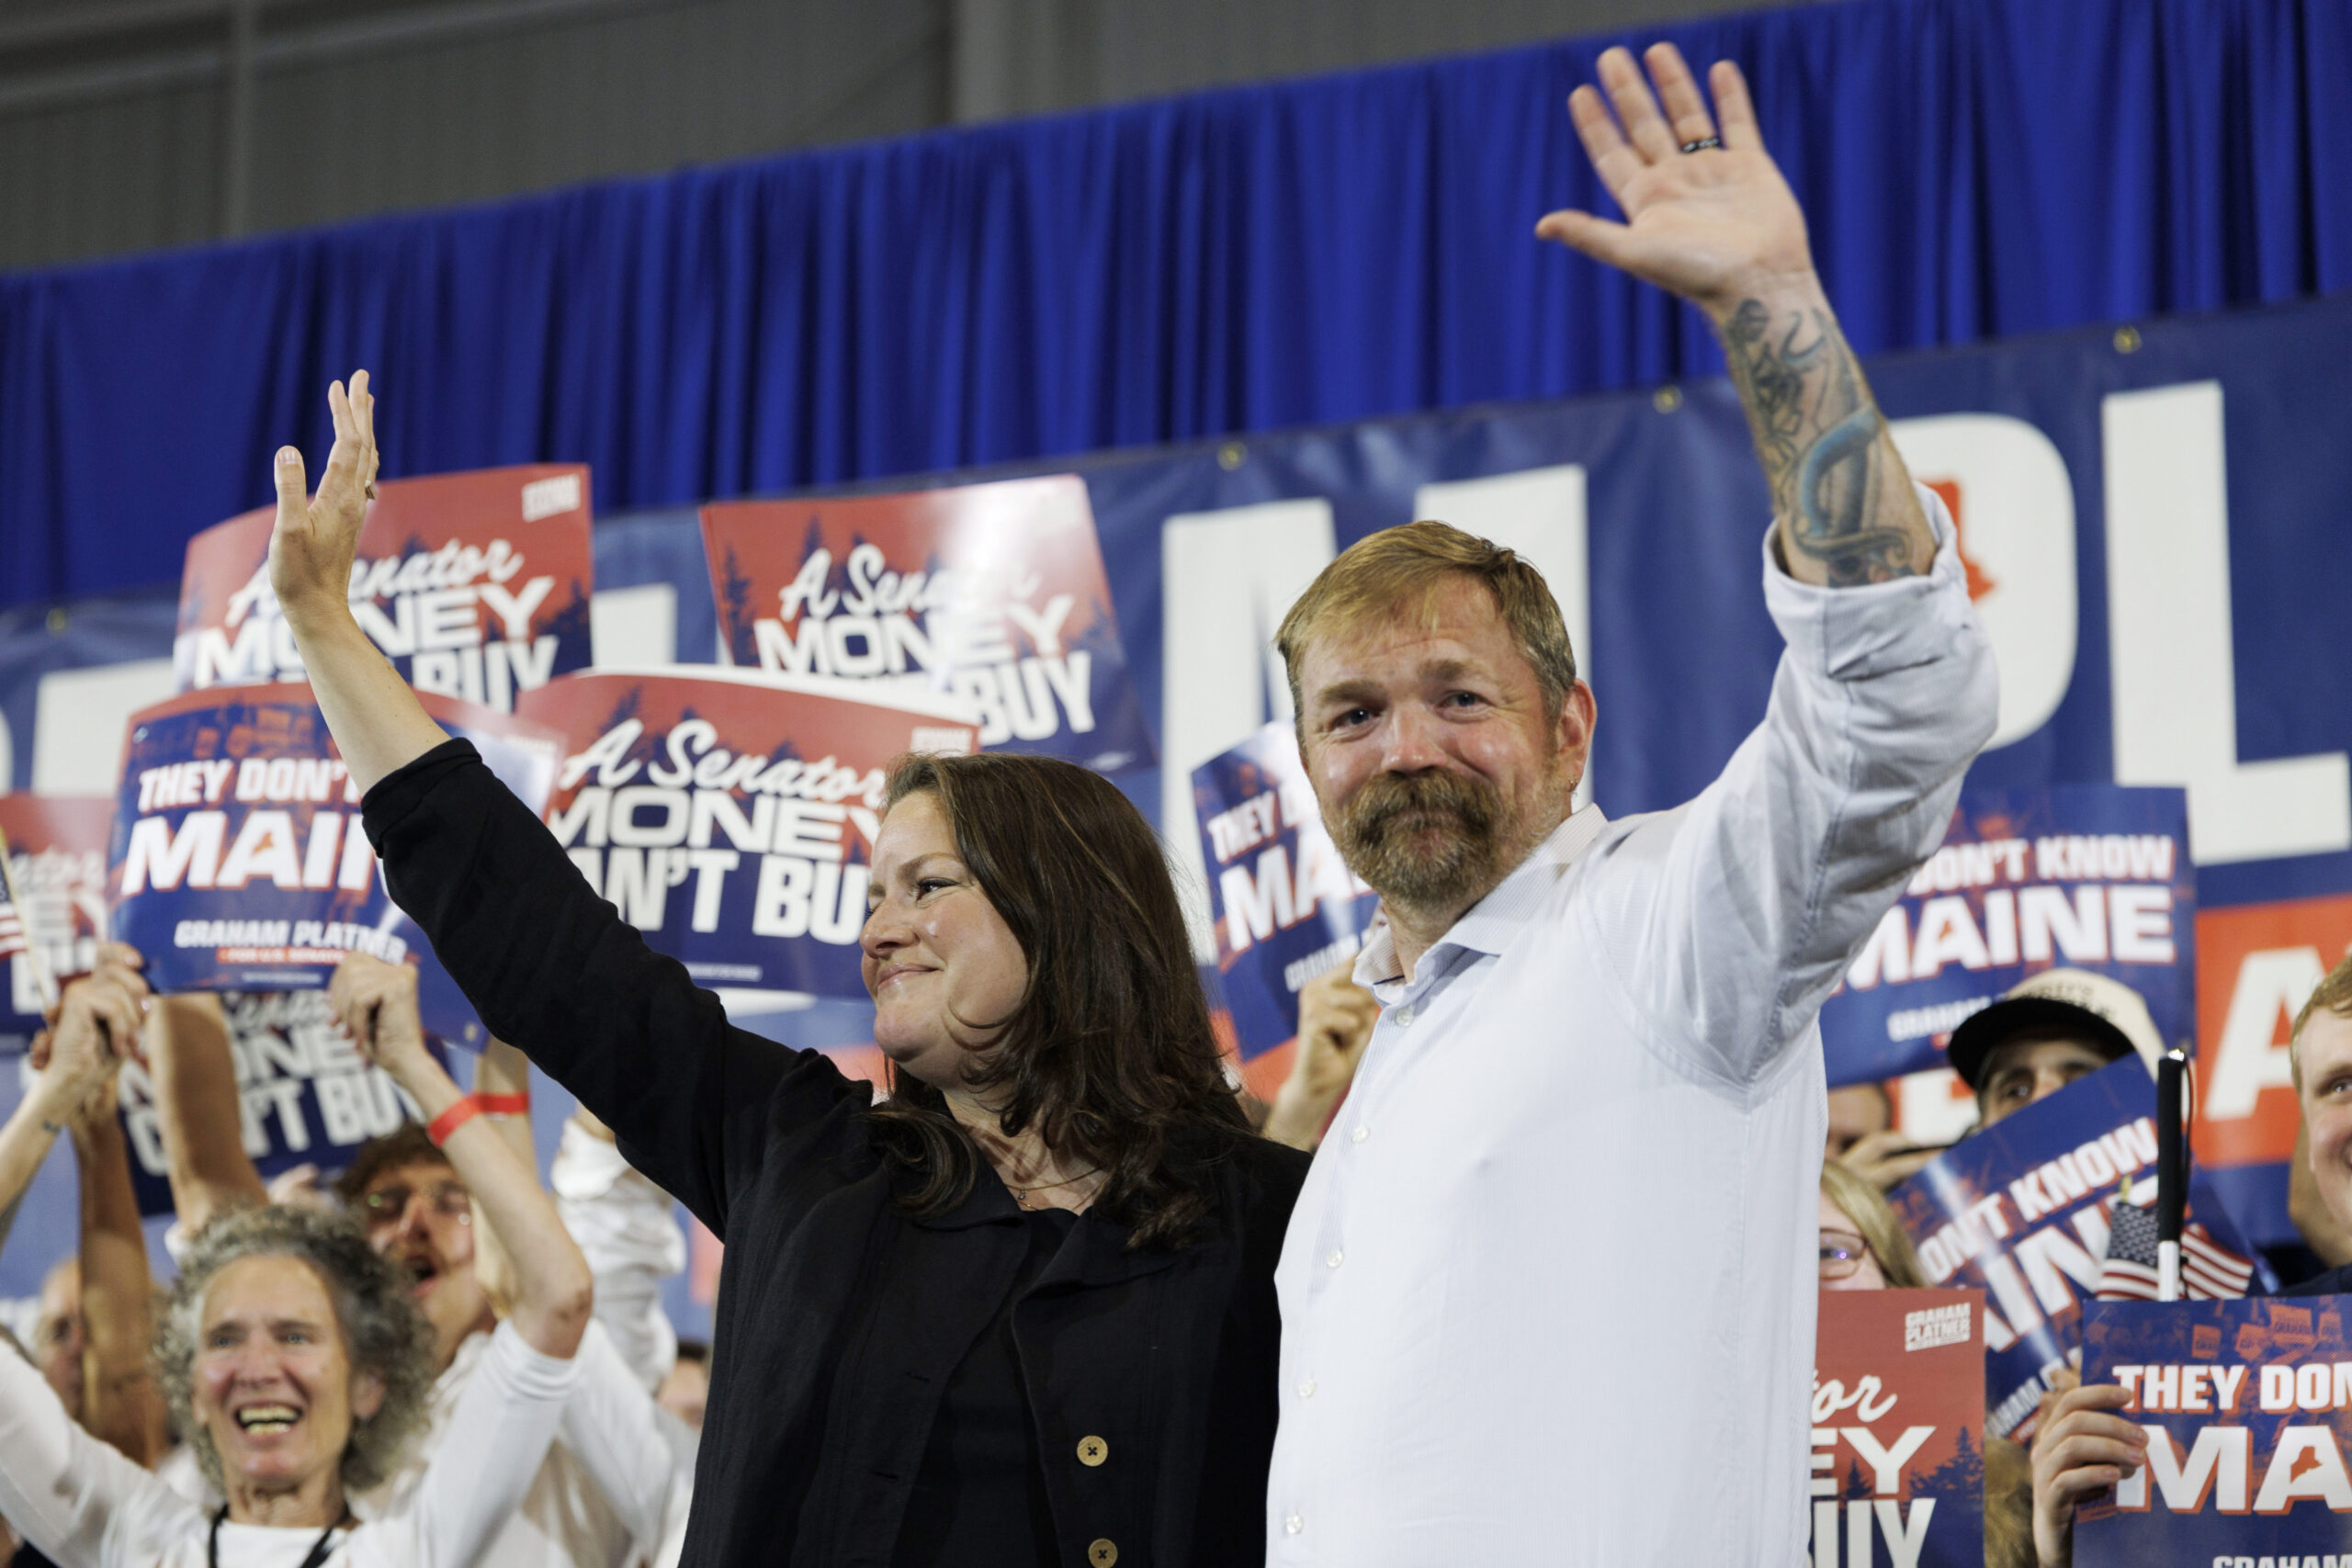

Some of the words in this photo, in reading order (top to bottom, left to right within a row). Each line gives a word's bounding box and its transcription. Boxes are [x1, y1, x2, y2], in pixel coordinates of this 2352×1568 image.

[779, 548, 840, 622] A
[753, 594, 1075, 676] MONEY
[138, 759, 233, 812] THEY
[559, 717, 644, 792] A
[1206, 789, 1276, 864] THEY
[2035, 835, 2176, 881] KNOW
[568, 847, 741, 932] AN'T
[752, 854, 873, 945] BU
[1842, 884, 2177, 991] MAINE
[2009, 1117, 2159, 1223] KNOW
[2112, 1364, 2246, 1411] THEY
[1811, 1425, 1938, 1495] EY
